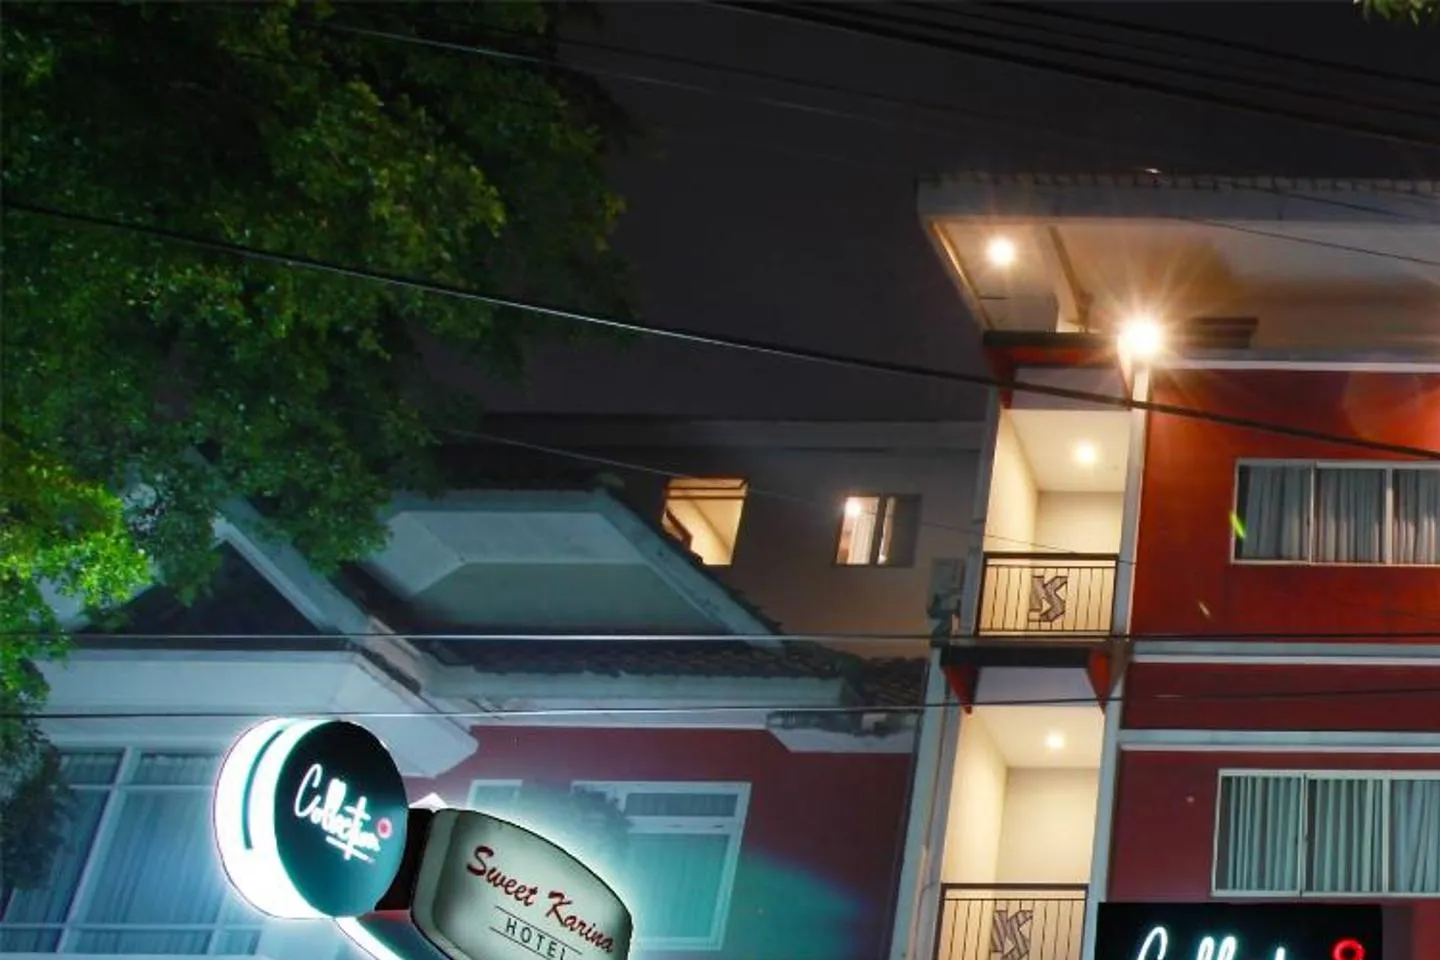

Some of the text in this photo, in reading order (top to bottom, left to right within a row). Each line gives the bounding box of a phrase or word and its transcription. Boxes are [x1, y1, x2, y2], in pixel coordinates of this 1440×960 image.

[294, 763, 380, 860] Collection
[466, 845, 614, 953] Sweet Karina
